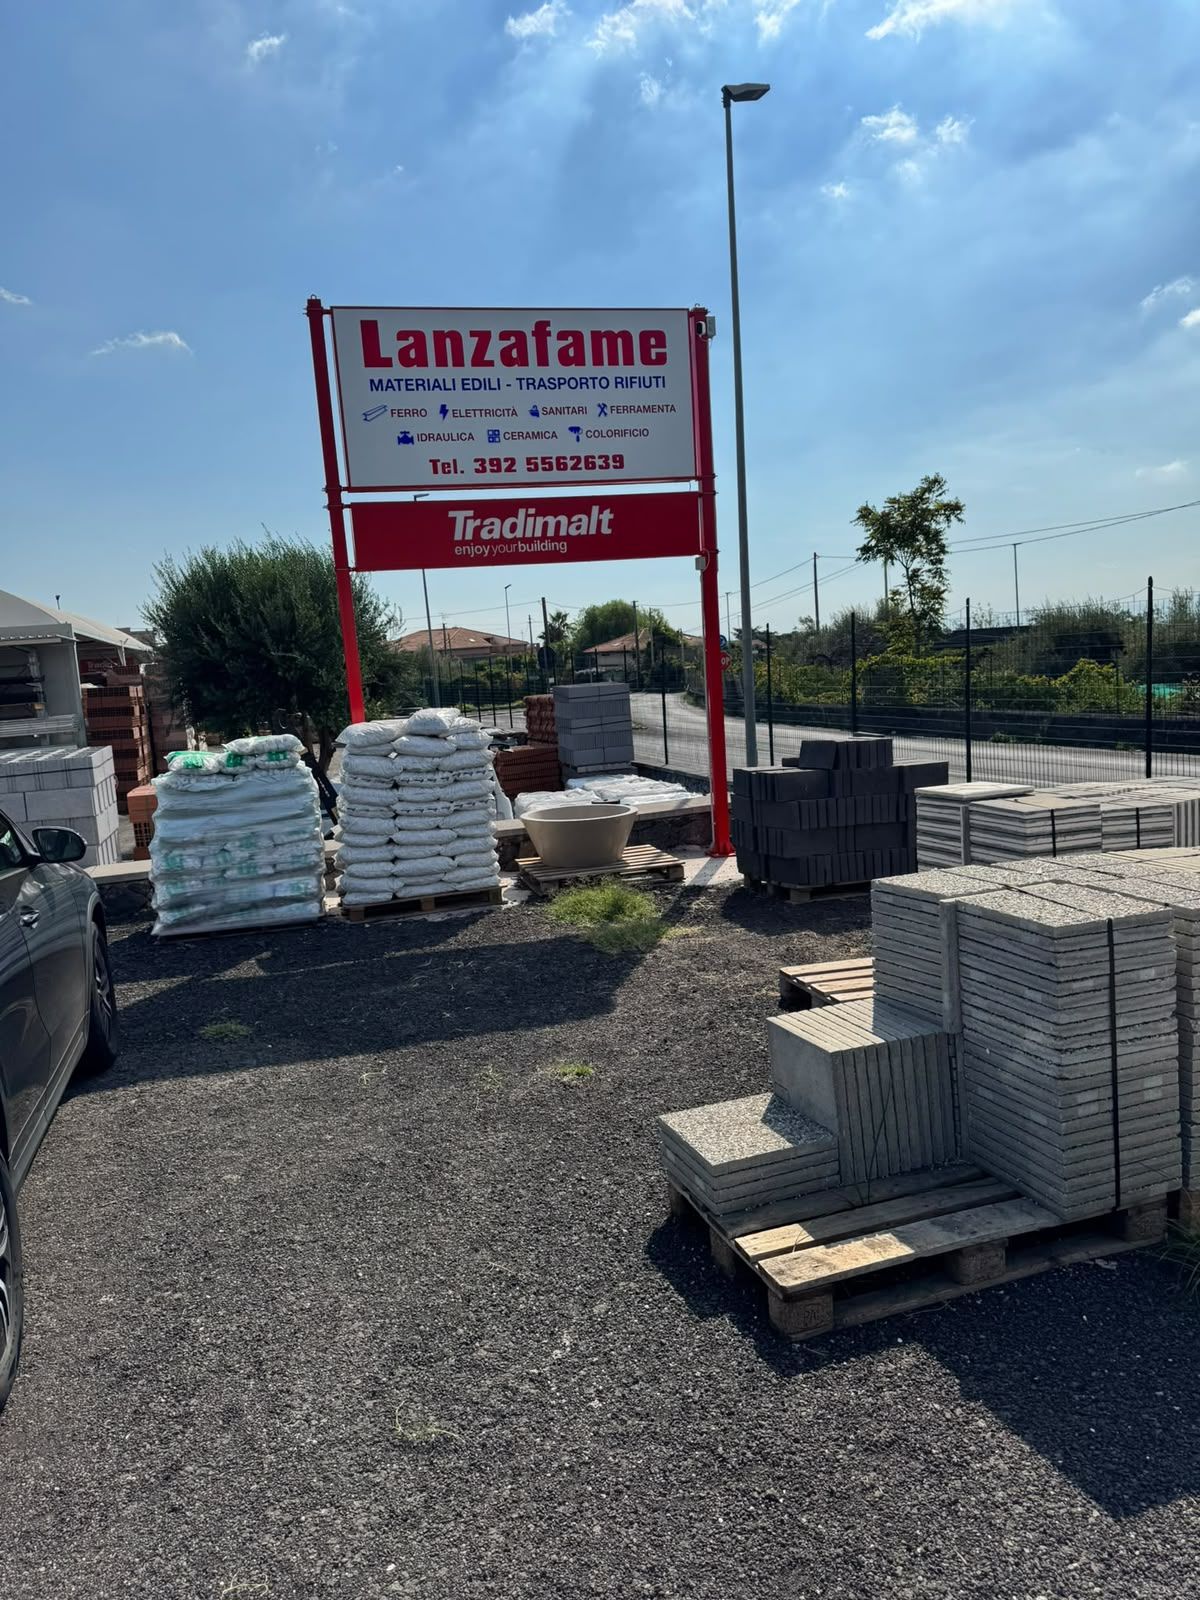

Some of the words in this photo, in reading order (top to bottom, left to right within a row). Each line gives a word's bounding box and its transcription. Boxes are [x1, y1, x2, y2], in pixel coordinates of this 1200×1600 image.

[360, 319, 667, 368] Lanzafame
[369, 378, 456, 392] MATERIALI
[461, 378, 501, 391] EDILI
[516, 376, 610, 390] TRASPORTO
[614, 375, 666, 389] RIFIUTI
[390, 408, 428, 418] FERRO
[452, 406, 518, 418] ELETTRICITÀ
[541, 406, 587, 416] SANITARI
[610, 404, 676, 415] FERRAMENTA
[417, 432, 475, 442] IDRAULICA
[503, 431, 558, 441] CERAMICA
[585, 428, 649, 439] COLORIFICIO
[429, 458, 464, 474] Tel.
[473, 457, 517, 474] 392
[526, 454, 624, 472] 5562639
[448, 505, 614, 541] Tradimalt
